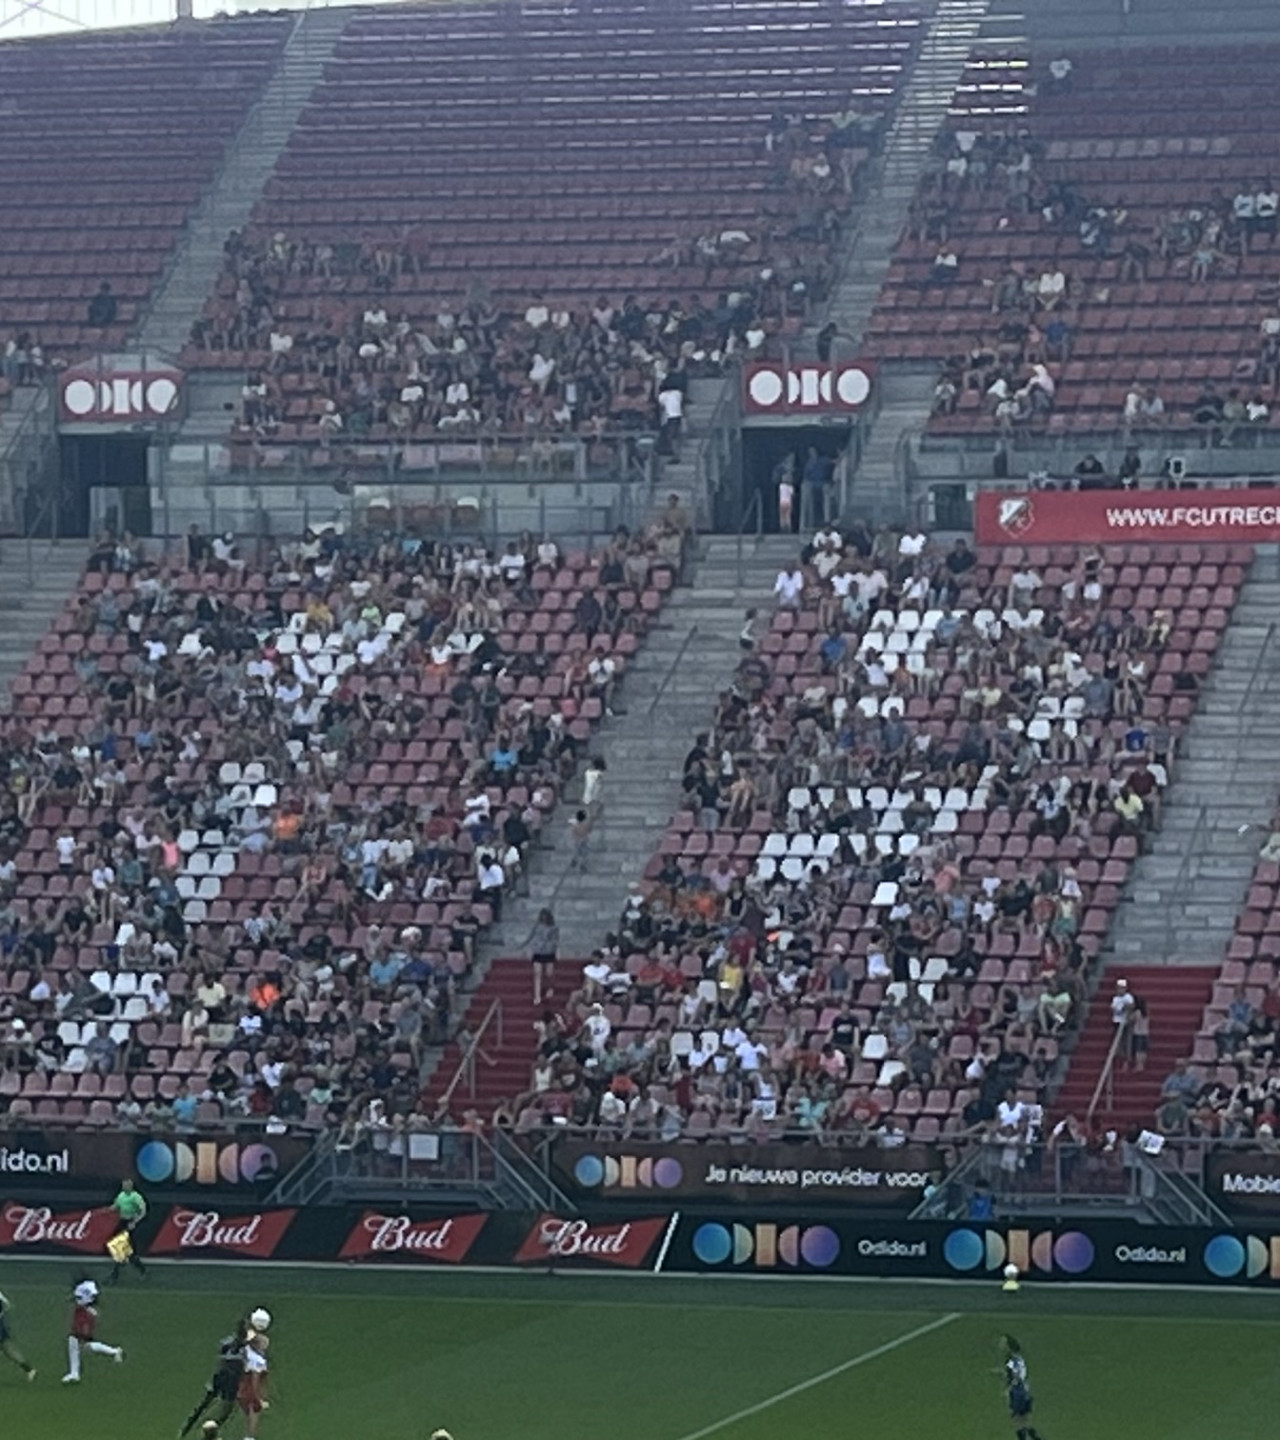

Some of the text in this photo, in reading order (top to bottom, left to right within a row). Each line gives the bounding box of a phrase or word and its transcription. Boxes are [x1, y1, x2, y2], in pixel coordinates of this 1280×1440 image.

[705, 1164, 931, 1189] Je nieuwe provider voor
[5, 1206, 93, 1242] Bud
[173, 1211, 262, 1247] Bud
[363, 1214, 454, 1251] Bud
[540, 1219, 631, 1256] Bud
[858, 1239, 927, 1257] Odido.nl
[1115, 1245, 1186, 1263] Odido.nl
